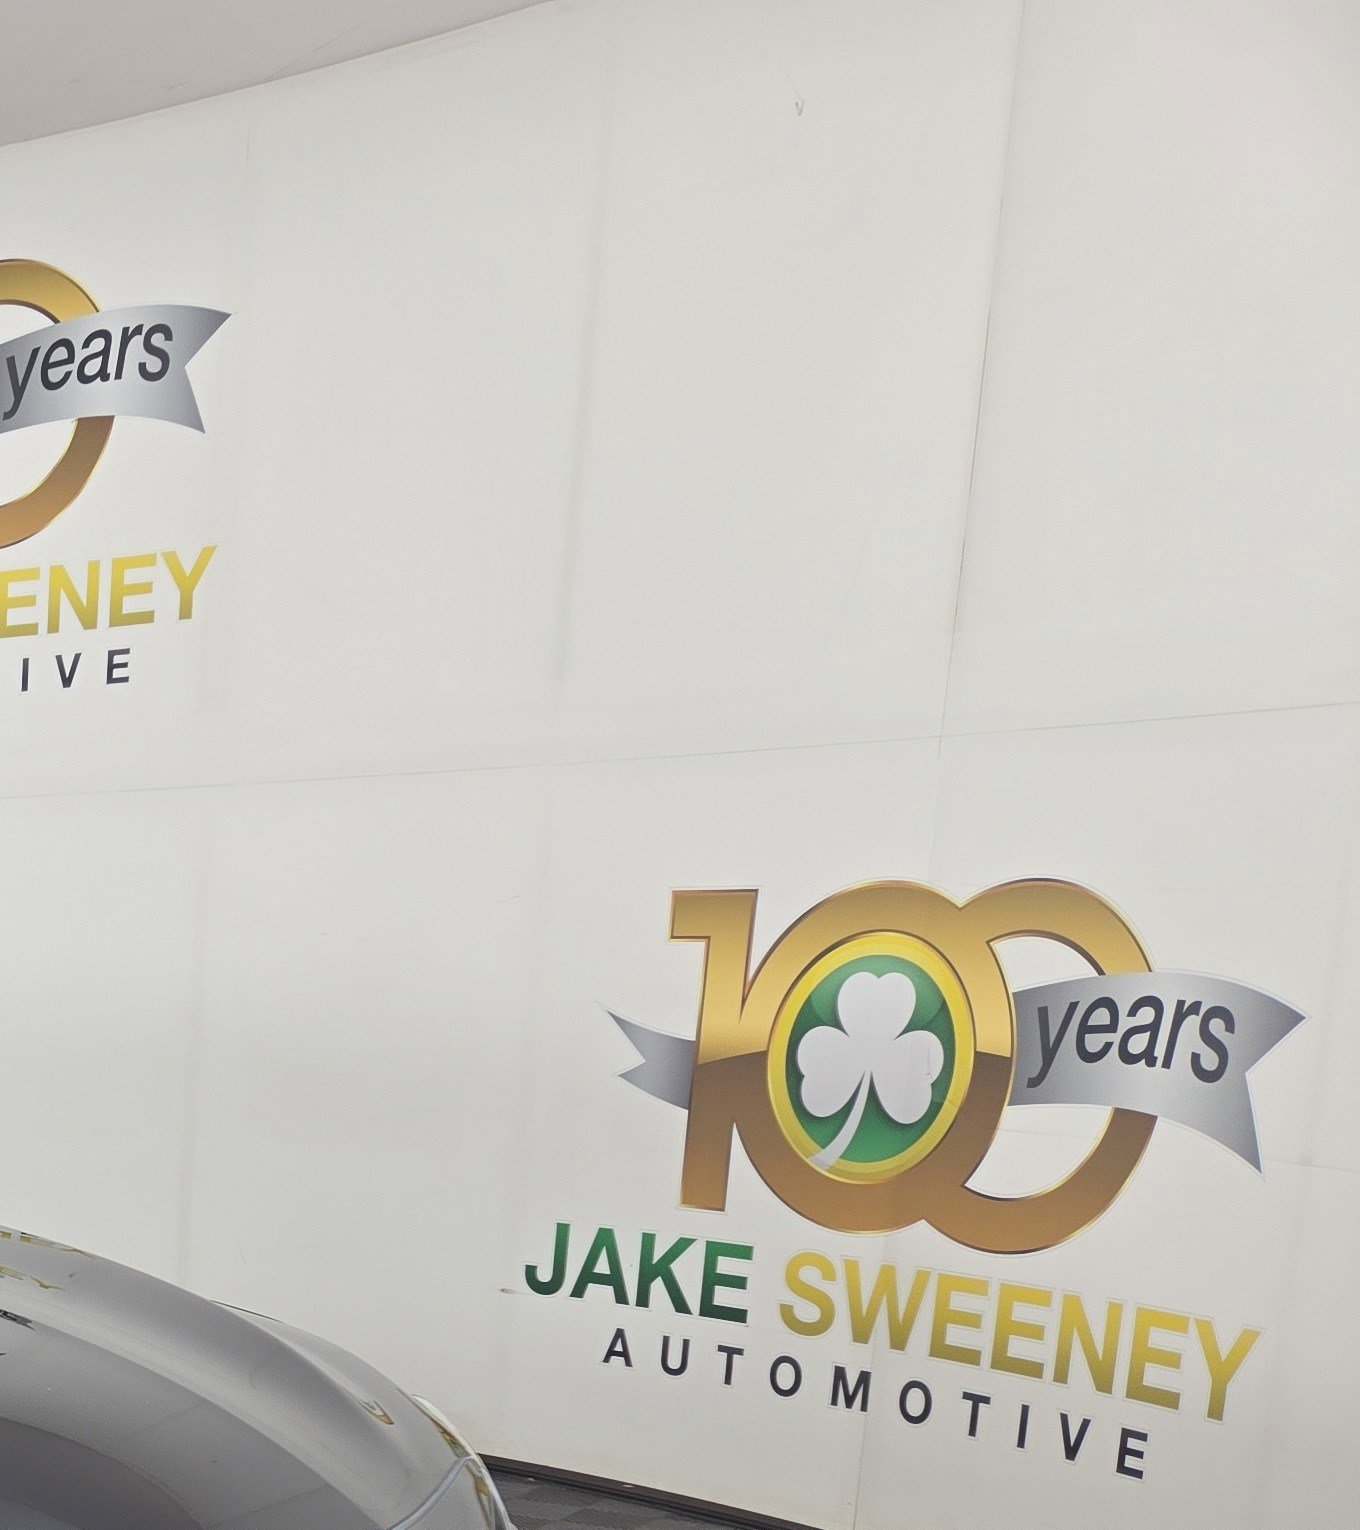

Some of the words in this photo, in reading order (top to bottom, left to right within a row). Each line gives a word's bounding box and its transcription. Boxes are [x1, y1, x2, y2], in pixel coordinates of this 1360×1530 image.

[2, 323, 173, 420] years
[1026, 995, 1235, 1088] years
[525, 1222, 754, 1324] JAKE
[779, 1252, 1262, 1421] SWEENEY
[603, 1328, 1148, 1479] AUTOMOTIVE
